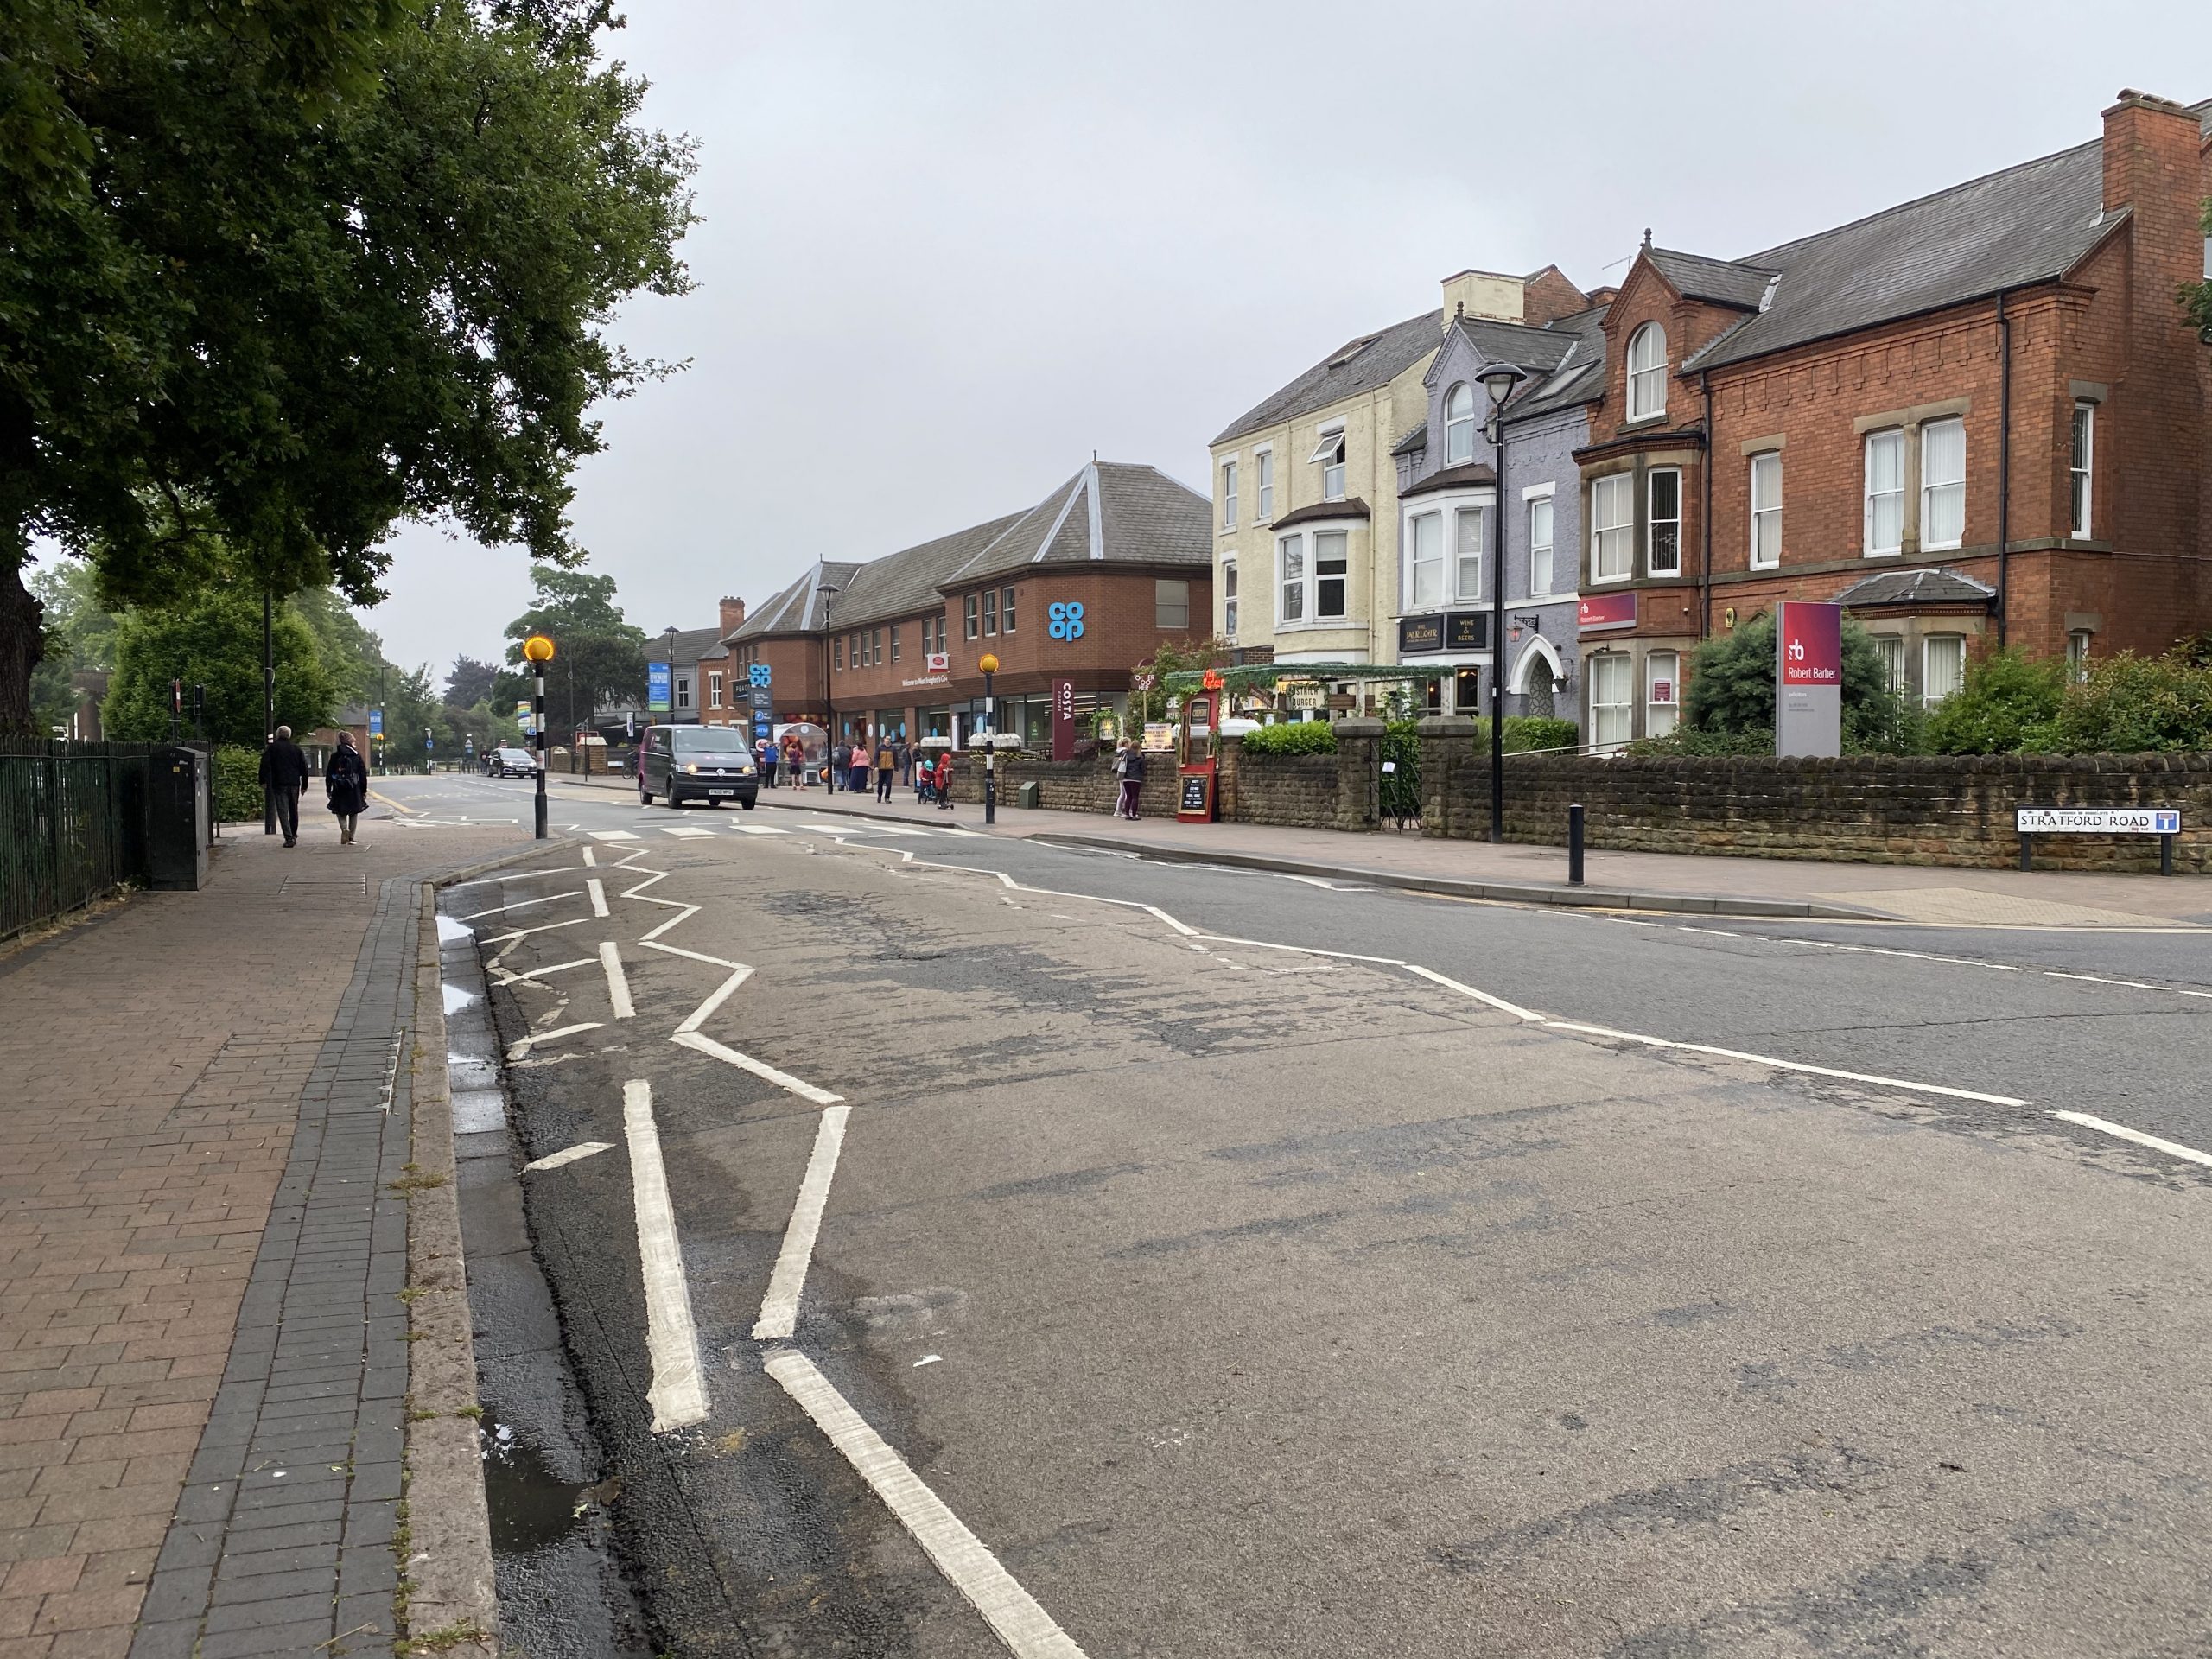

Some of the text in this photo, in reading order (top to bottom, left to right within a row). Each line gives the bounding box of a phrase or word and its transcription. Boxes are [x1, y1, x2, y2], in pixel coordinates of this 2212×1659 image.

[1406, 629, 1438, 639] PARLOUR
[1788, 666, 1837, 679] Robert Barber
[1063, 683, 1071, 721] COSTA
[2020, 816, 2149, 826] STRATFORD ROAD
